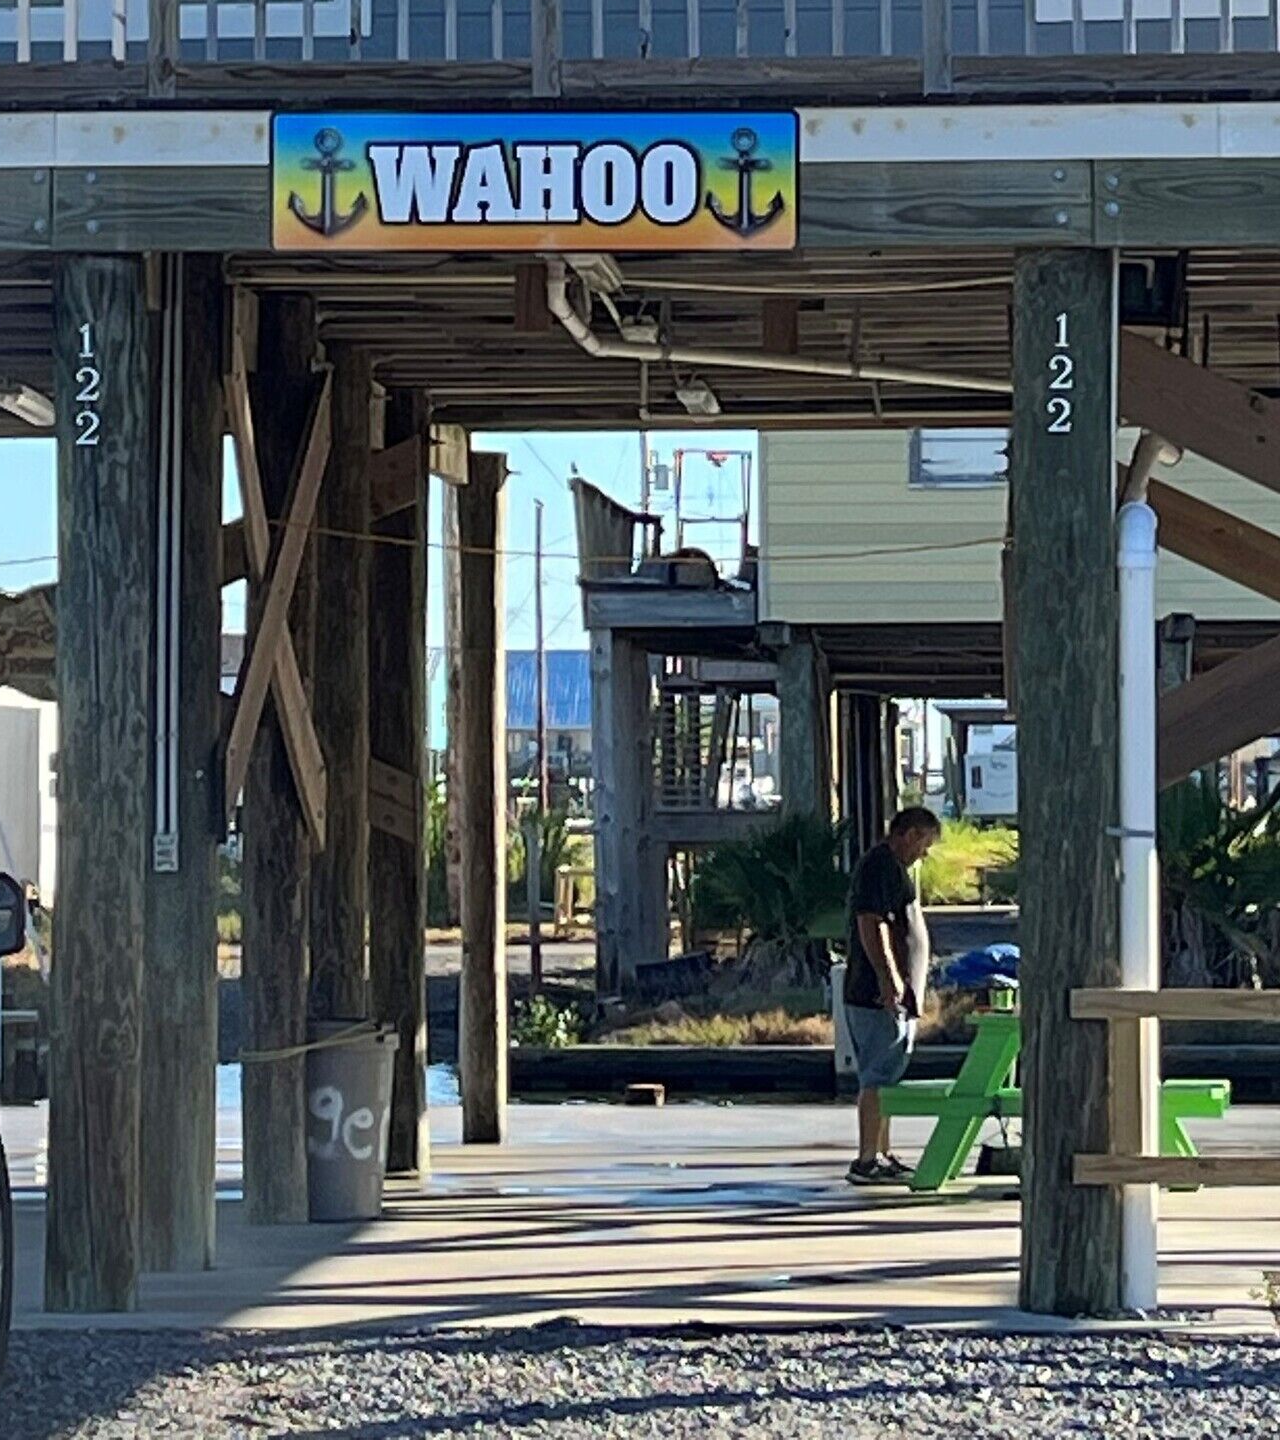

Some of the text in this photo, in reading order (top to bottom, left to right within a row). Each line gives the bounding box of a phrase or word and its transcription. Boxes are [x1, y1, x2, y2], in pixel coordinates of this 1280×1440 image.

[368, 140, 700, 224] WAHOO
[75, 322, 100, 445] 122
[1046, 312, 1073, 433] 122
